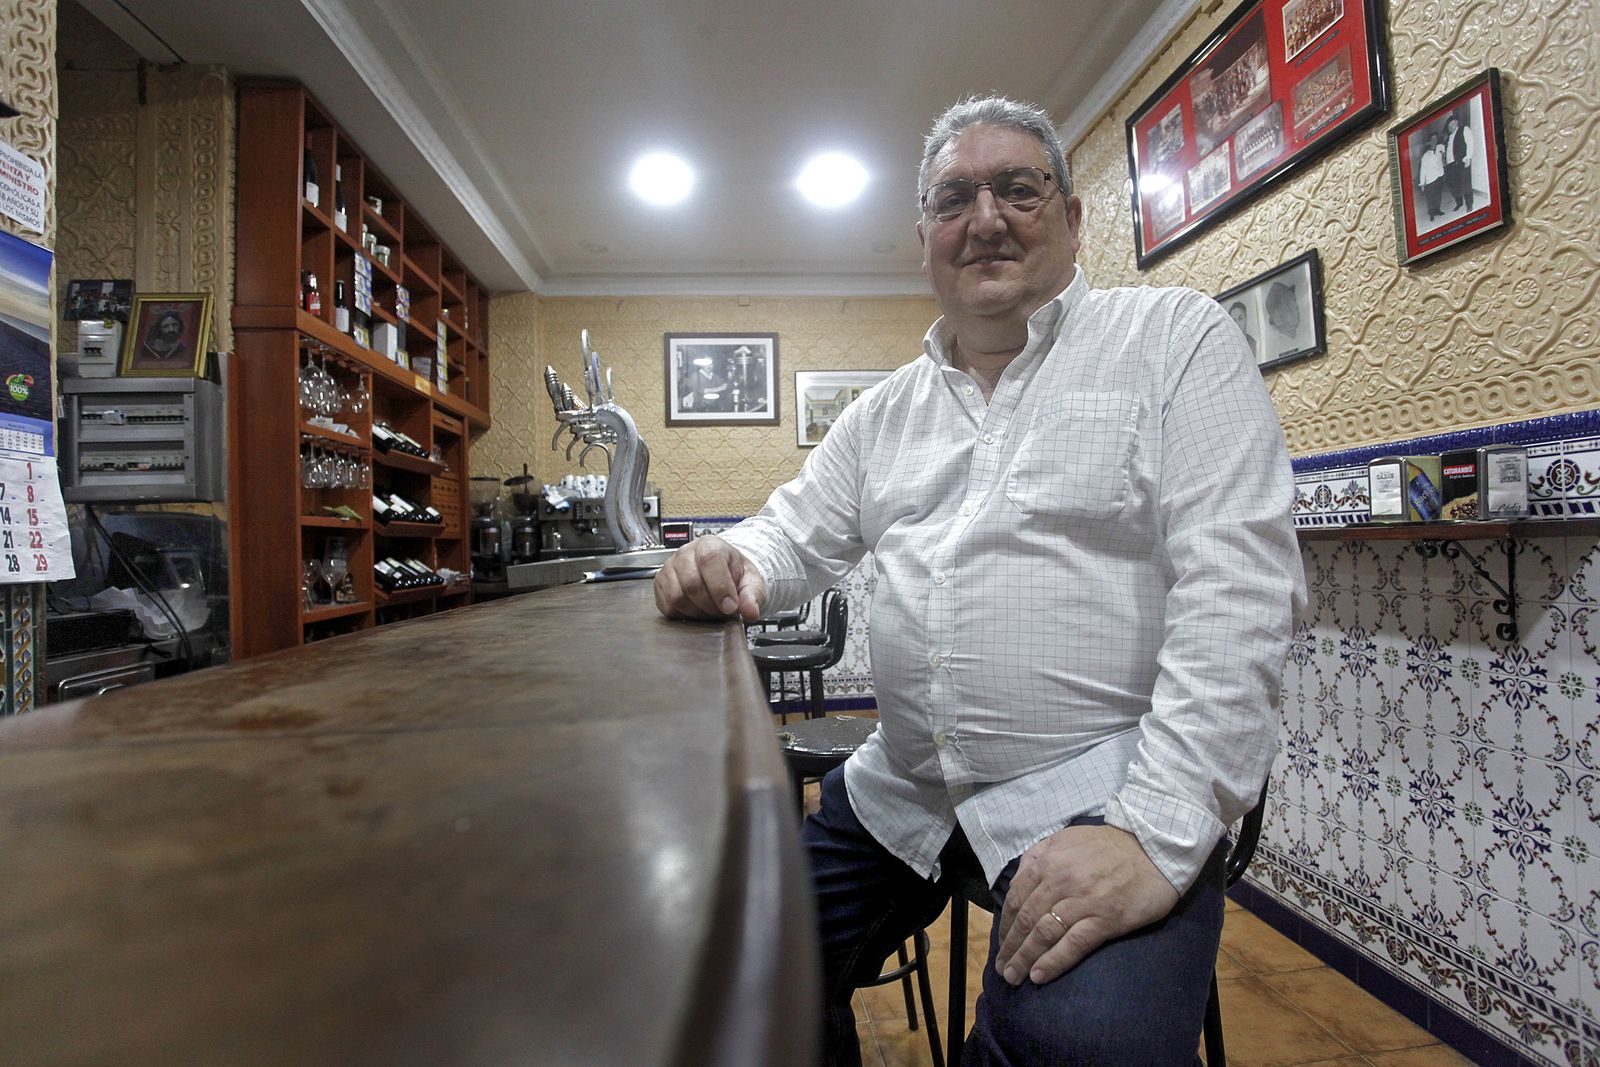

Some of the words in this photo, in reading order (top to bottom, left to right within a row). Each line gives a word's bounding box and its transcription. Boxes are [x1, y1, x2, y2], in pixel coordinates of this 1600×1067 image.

[9, 384, 29, 396] 100%
[26, 462, 33, 480] 1
[0, 482, 5, 500] 7
[26, 485, 35, 503] 8
[0, 506, 11, 525] 14
[27, 508, 38, 527] 15
[2, 530, 14, 549] 21
[29, 531, 43, 549] 22
[5, 553, 20, 573] 28
[32, 553, 48, 573] 29
